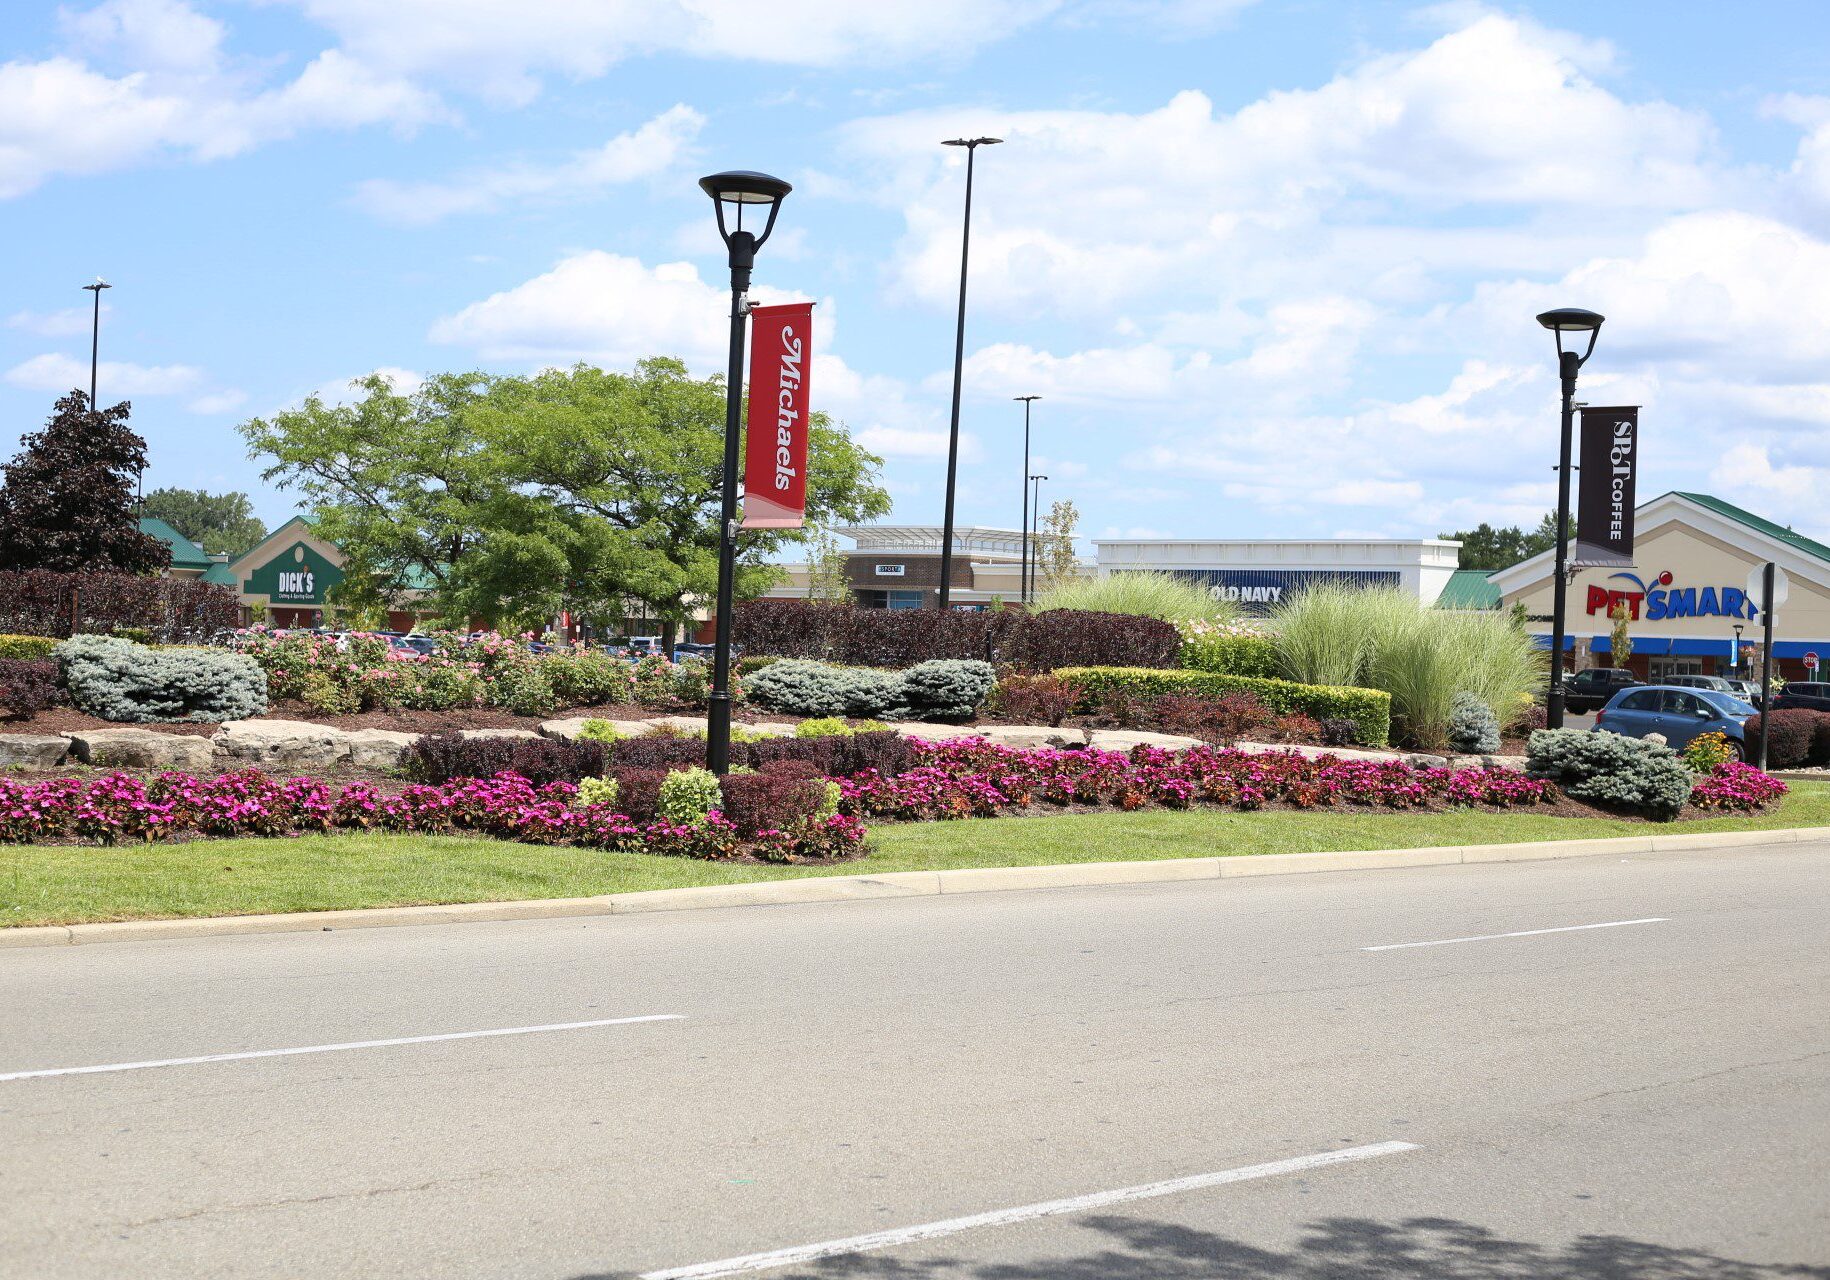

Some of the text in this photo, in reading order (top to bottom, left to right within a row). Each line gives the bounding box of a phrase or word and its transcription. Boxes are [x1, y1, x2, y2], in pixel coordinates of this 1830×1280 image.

[775, 325, 802, 490] Michaels
[1610, 478, 1624, 540] COFFEE
[279, 572, 314, 593] DICK'S
[1210, 586, 1282, 602] OLD NAVY
